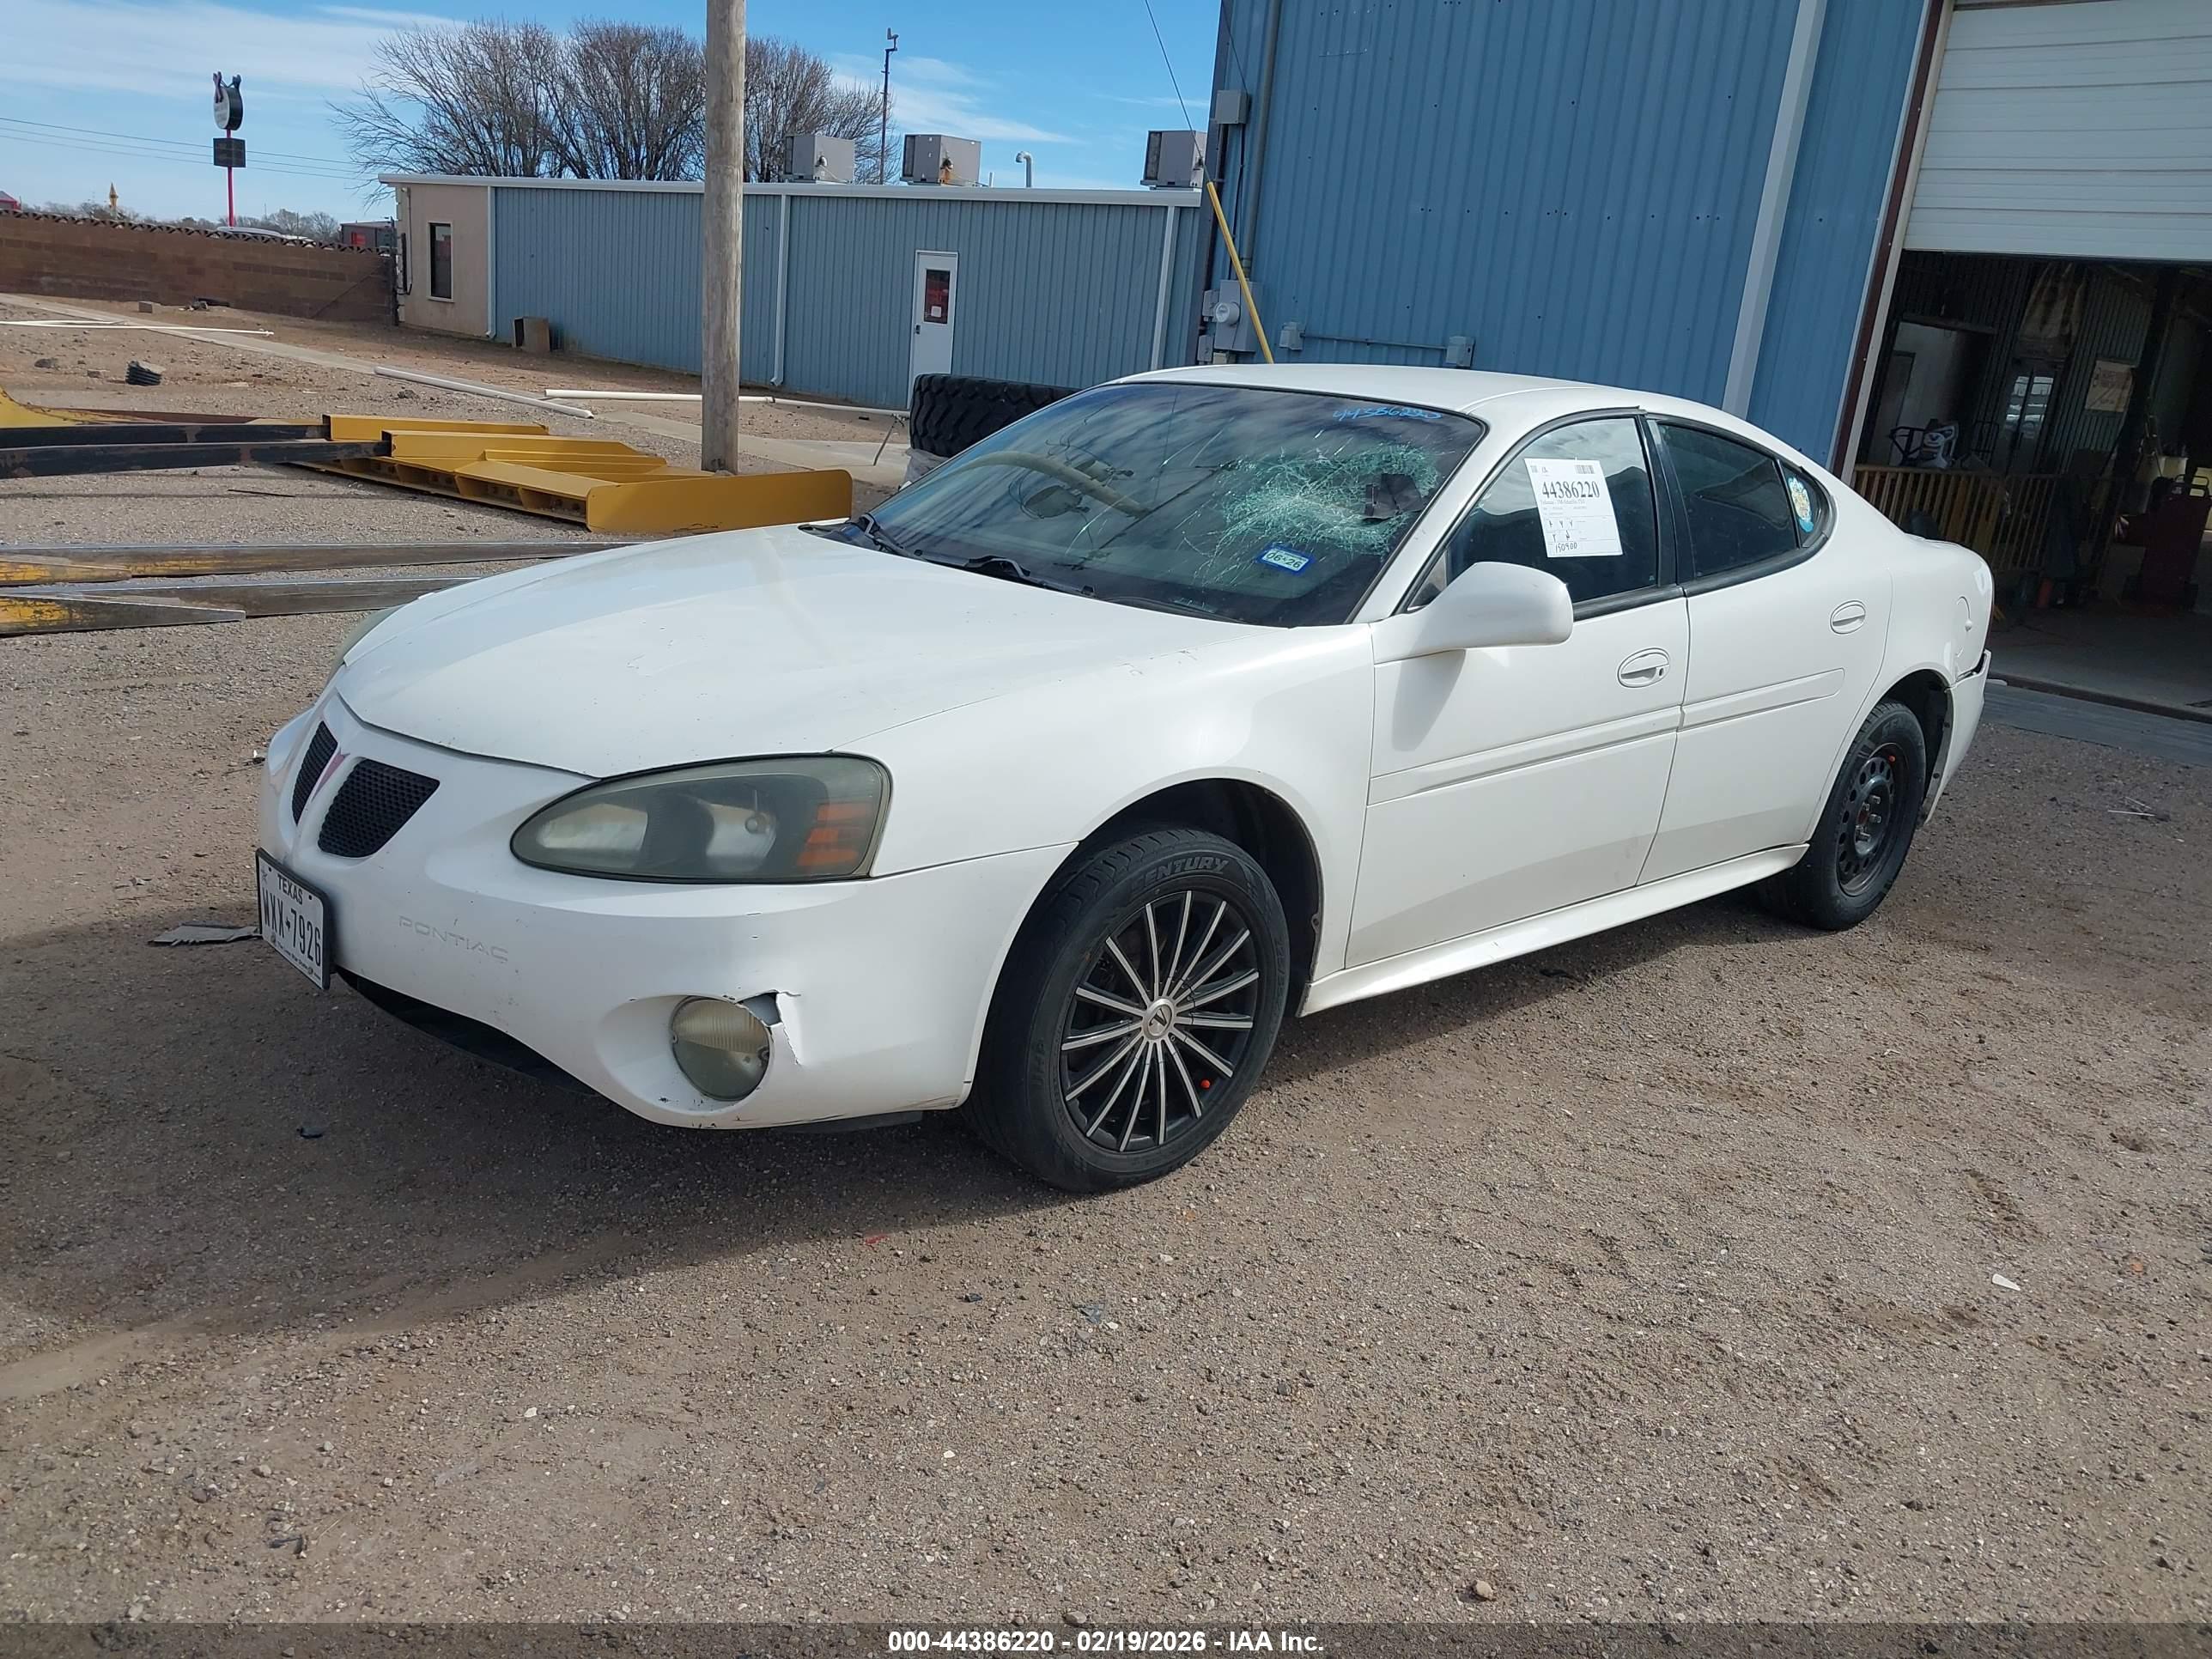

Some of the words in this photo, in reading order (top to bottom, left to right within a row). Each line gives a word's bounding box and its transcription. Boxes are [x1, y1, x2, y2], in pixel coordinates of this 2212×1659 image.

[1542, 481, 1601, 499] 44386220
[1266, 551, 1283, 562] 06
[1285, 558, 1304, 568] 26
[277, 873, 303, 906] TEXAS
[398, 915, 509, 963] PONTIAC
